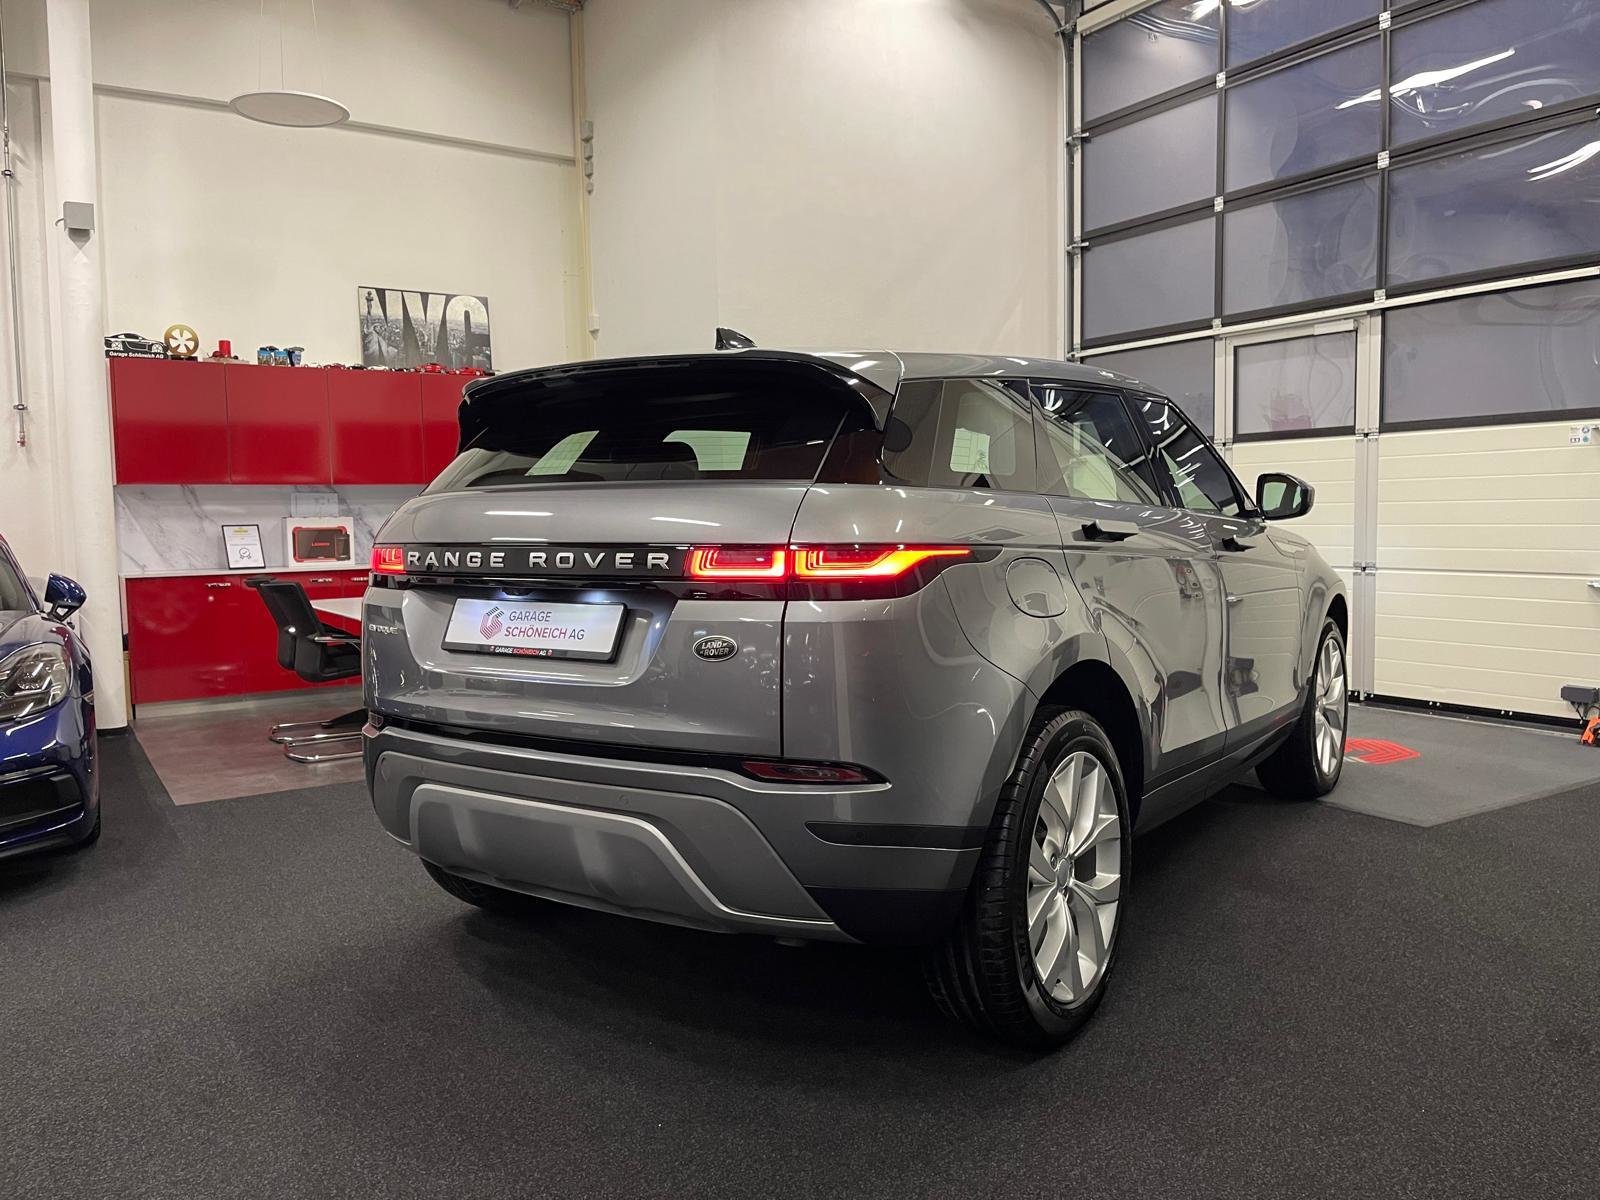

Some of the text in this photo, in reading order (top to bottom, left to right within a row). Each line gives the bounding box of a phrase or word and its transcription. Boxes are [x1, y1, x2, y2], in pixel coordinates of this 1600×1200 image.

[407, 551, 670, 570] RANGE ROVER
[509, 611, 552, 622] GARAGE
[504, 625, 585, 640] SCHÖNEICH AG
[702, 641, 722, 649] LAND
[704, 648, 729, 656] ROVER
